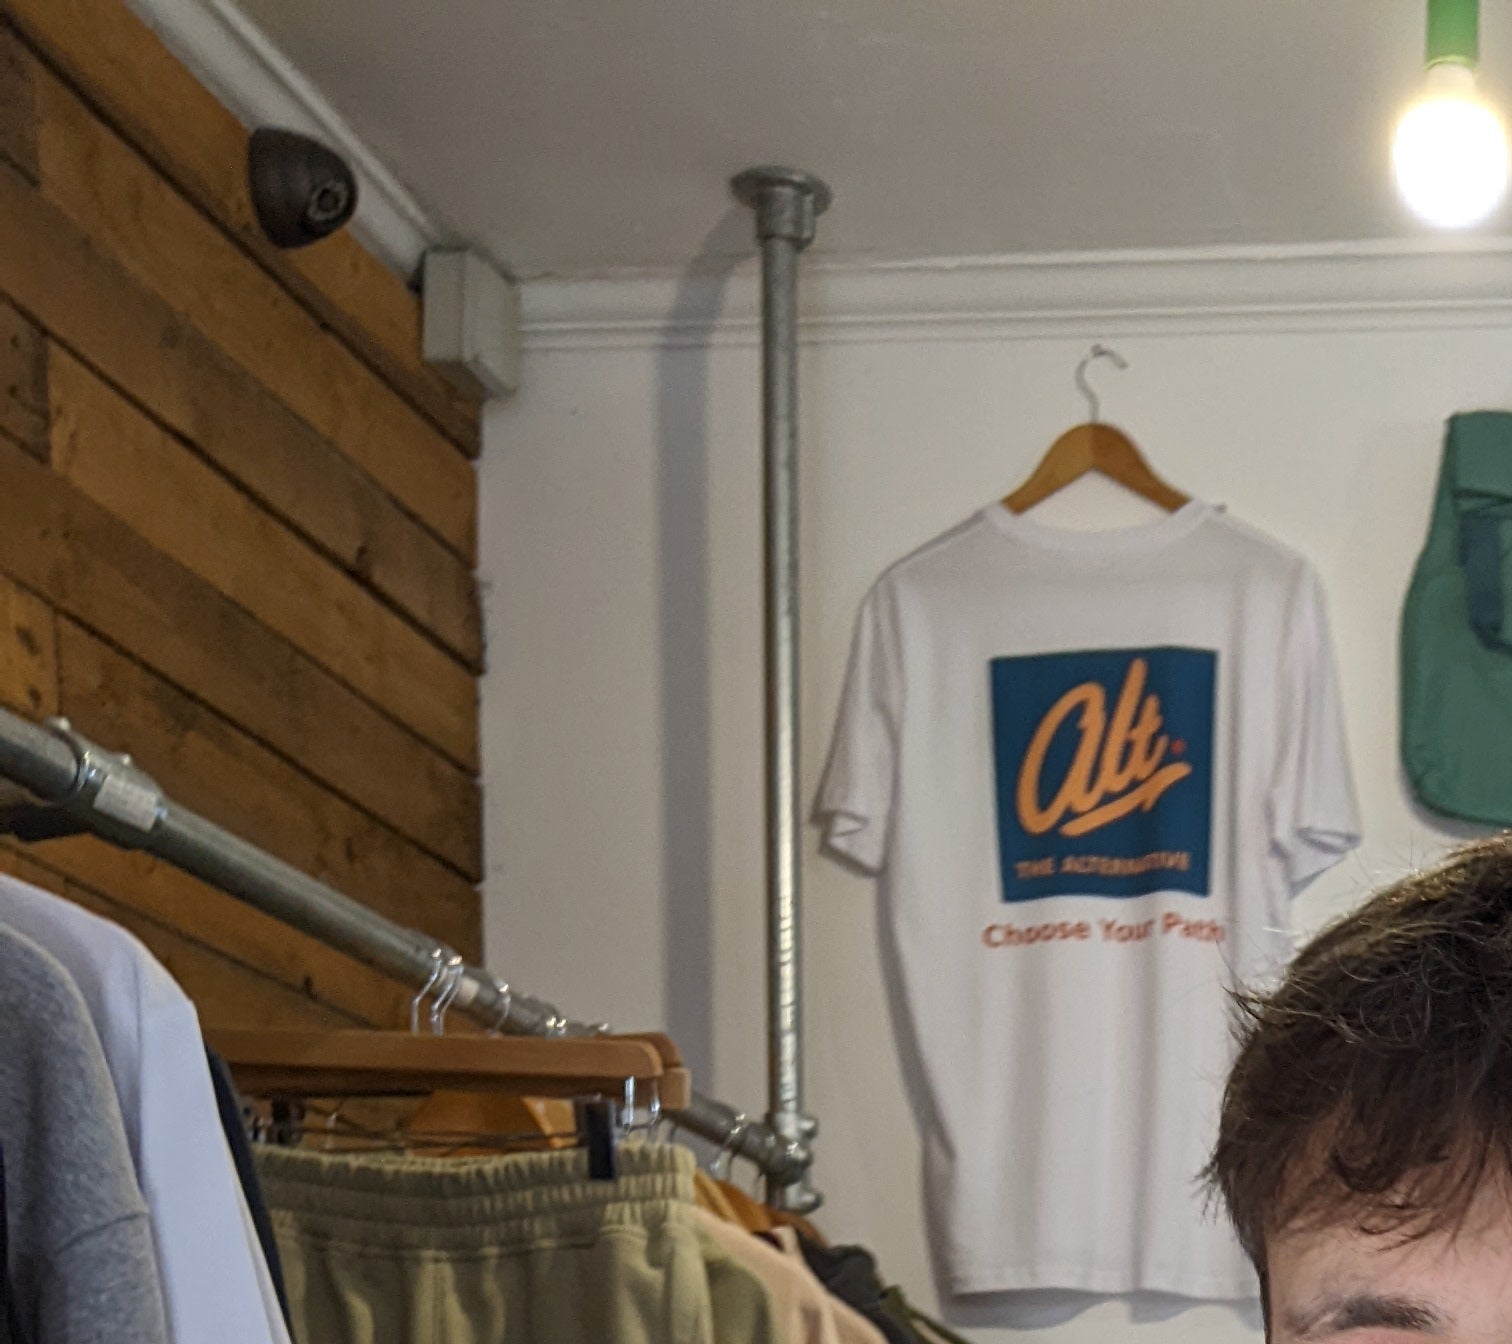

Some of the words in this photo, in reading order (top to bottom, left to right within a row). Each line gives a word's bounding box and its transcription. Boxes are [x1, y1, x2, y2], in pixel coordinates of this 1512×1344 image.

[980, 919, 1091, 949] Choose
[1098, 916, 1154, 944] Your
[1161, 910, 1227, 944] Path
